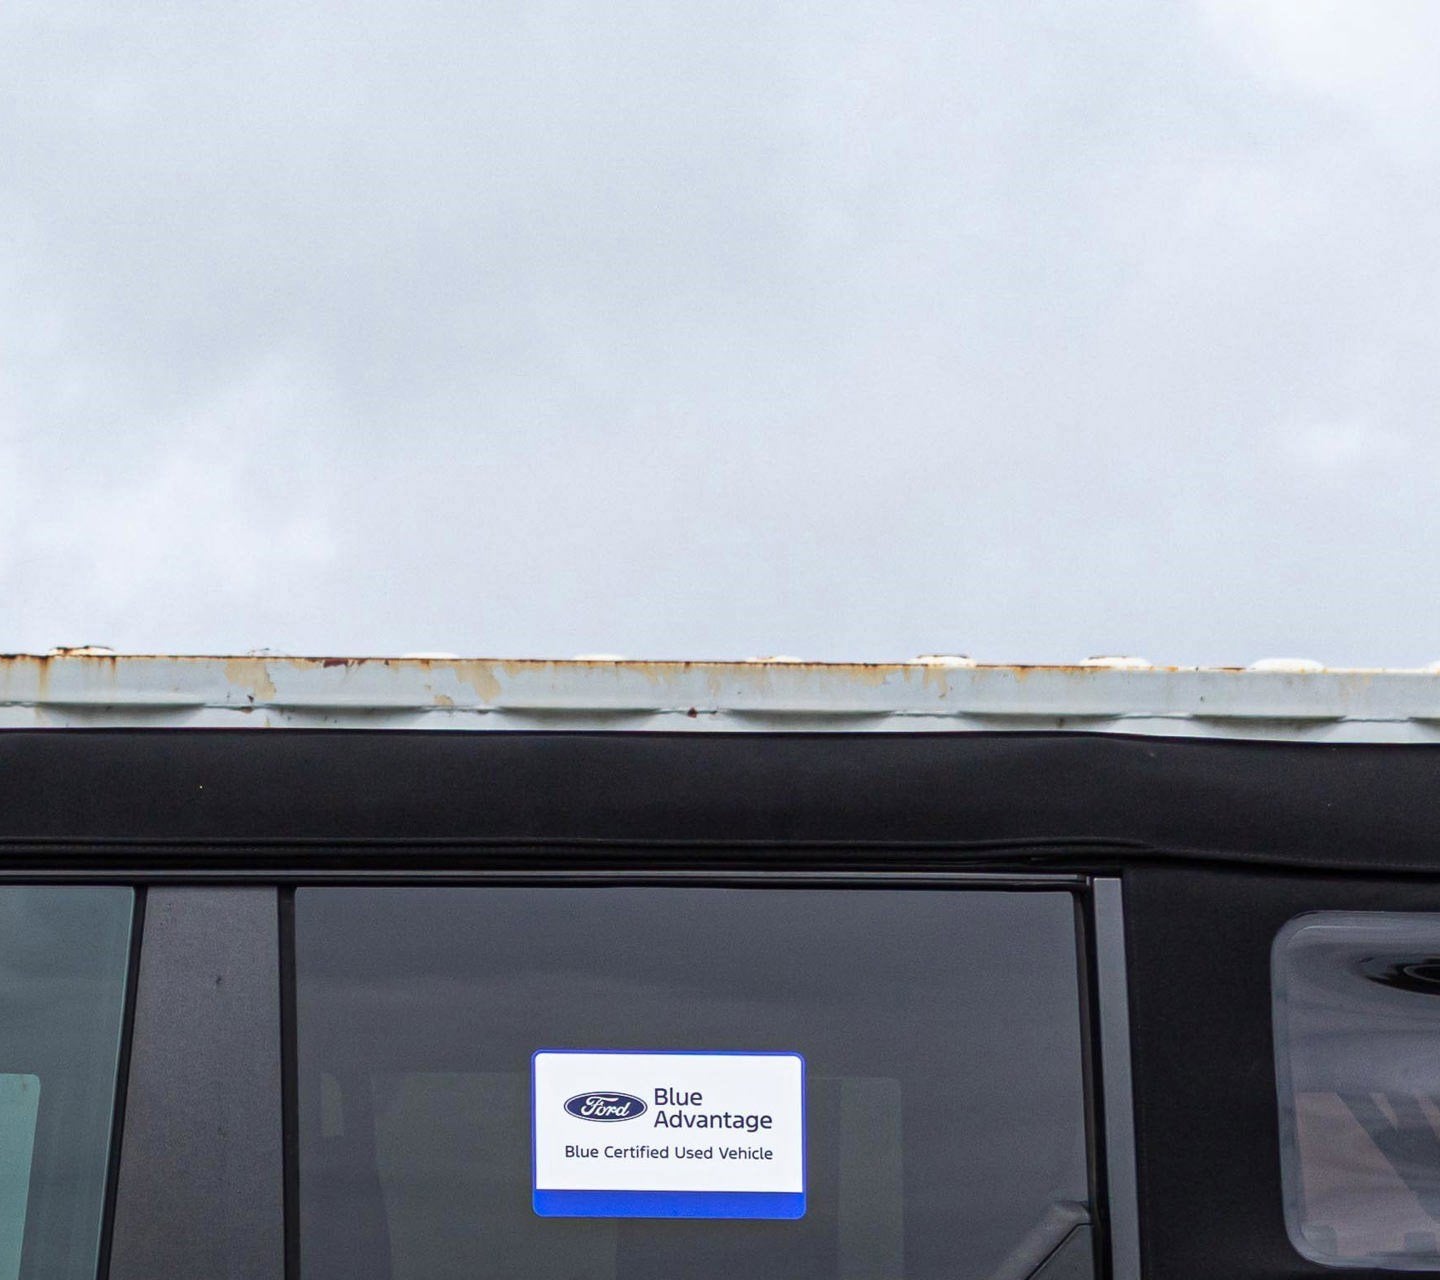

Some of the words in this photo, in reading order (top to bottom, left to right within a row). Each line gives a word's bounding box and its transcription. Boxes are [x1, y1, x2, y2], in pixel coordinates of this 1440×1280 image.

[580, 1096, 631, 1117] Ford
[653, 1087, 703, 1106] Blue
[653, 1110, 773, 1132] Advantage
[564, 1145, 599, 1158] Blue
[604, 1145, 669, 1159] Certified
[675, 1146, 713, 1160] Used
[718, 1146, 774, 1160] Vehicle
